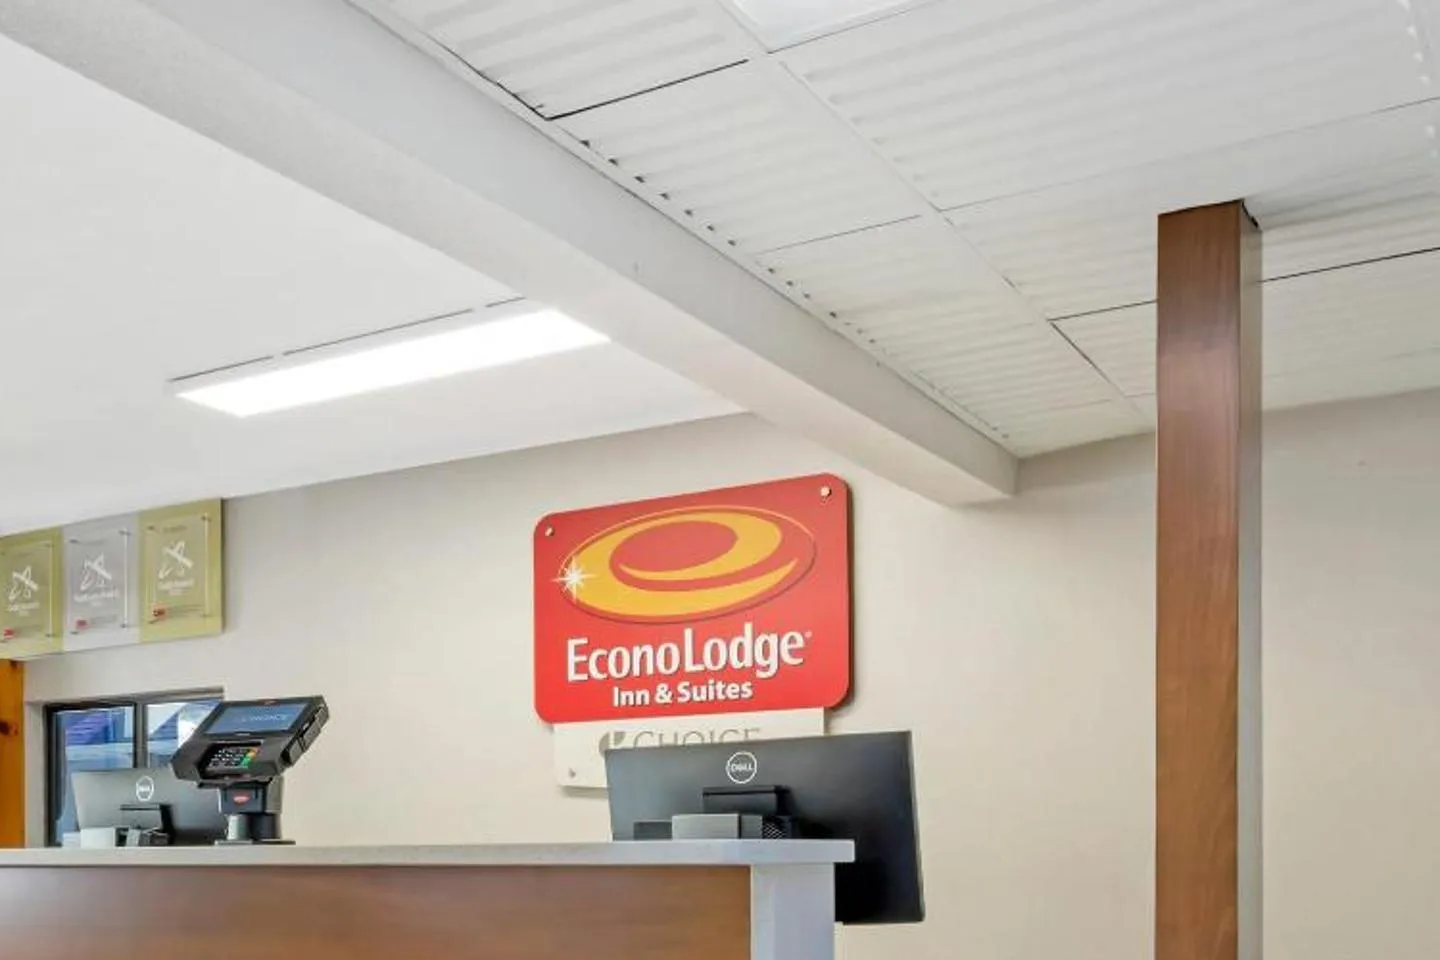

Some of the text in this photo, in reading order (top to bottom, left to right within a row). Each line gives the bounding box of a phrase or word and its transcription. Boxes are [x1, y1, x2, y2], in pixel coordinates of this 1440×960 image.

[567, 621, 805, 682] EconoLodge
[612, 679, 753, 707] Inn & Suites
